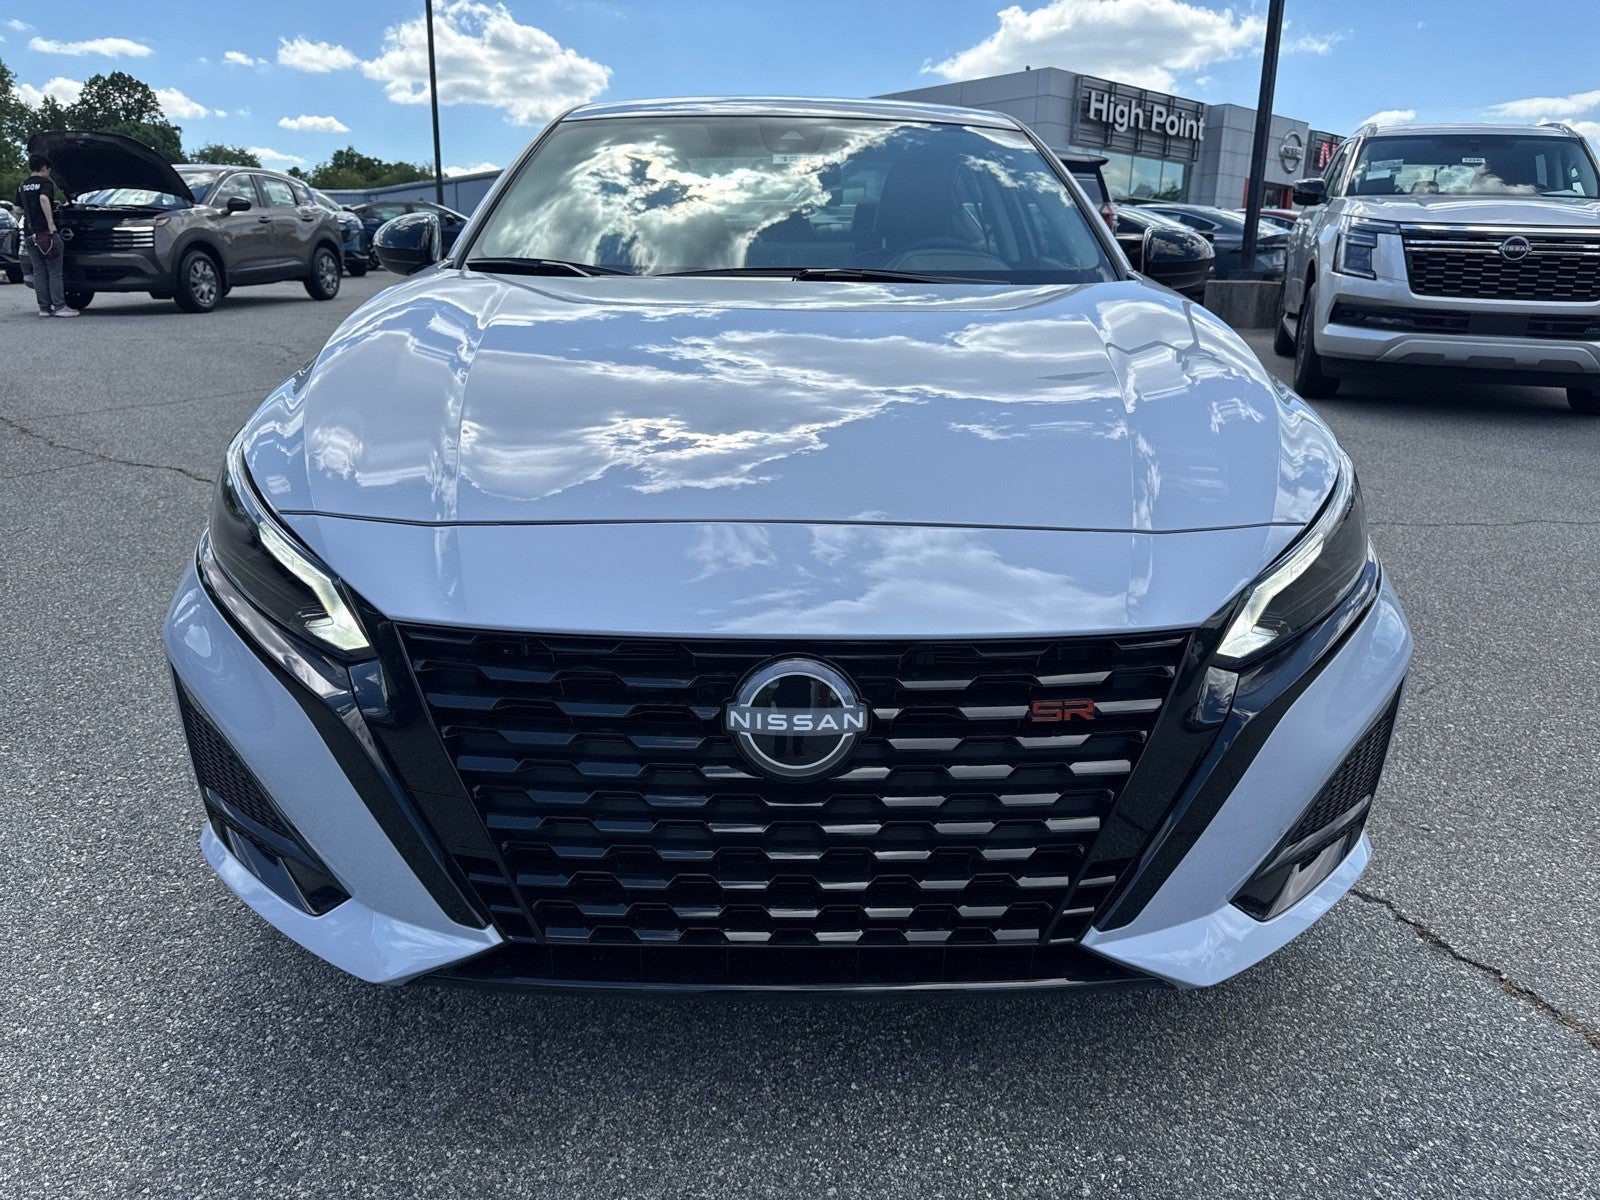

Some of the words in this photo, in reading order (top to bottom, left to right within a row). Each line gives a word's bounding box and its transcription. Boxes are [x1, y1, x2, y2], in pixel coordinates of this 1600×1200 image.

[1089, 90, 1145, 133] High
[1151, 104, 1205, 141] Point
[729, 710, 865, 731] NISSAN
[1031, 700, 1095, 722] SR
